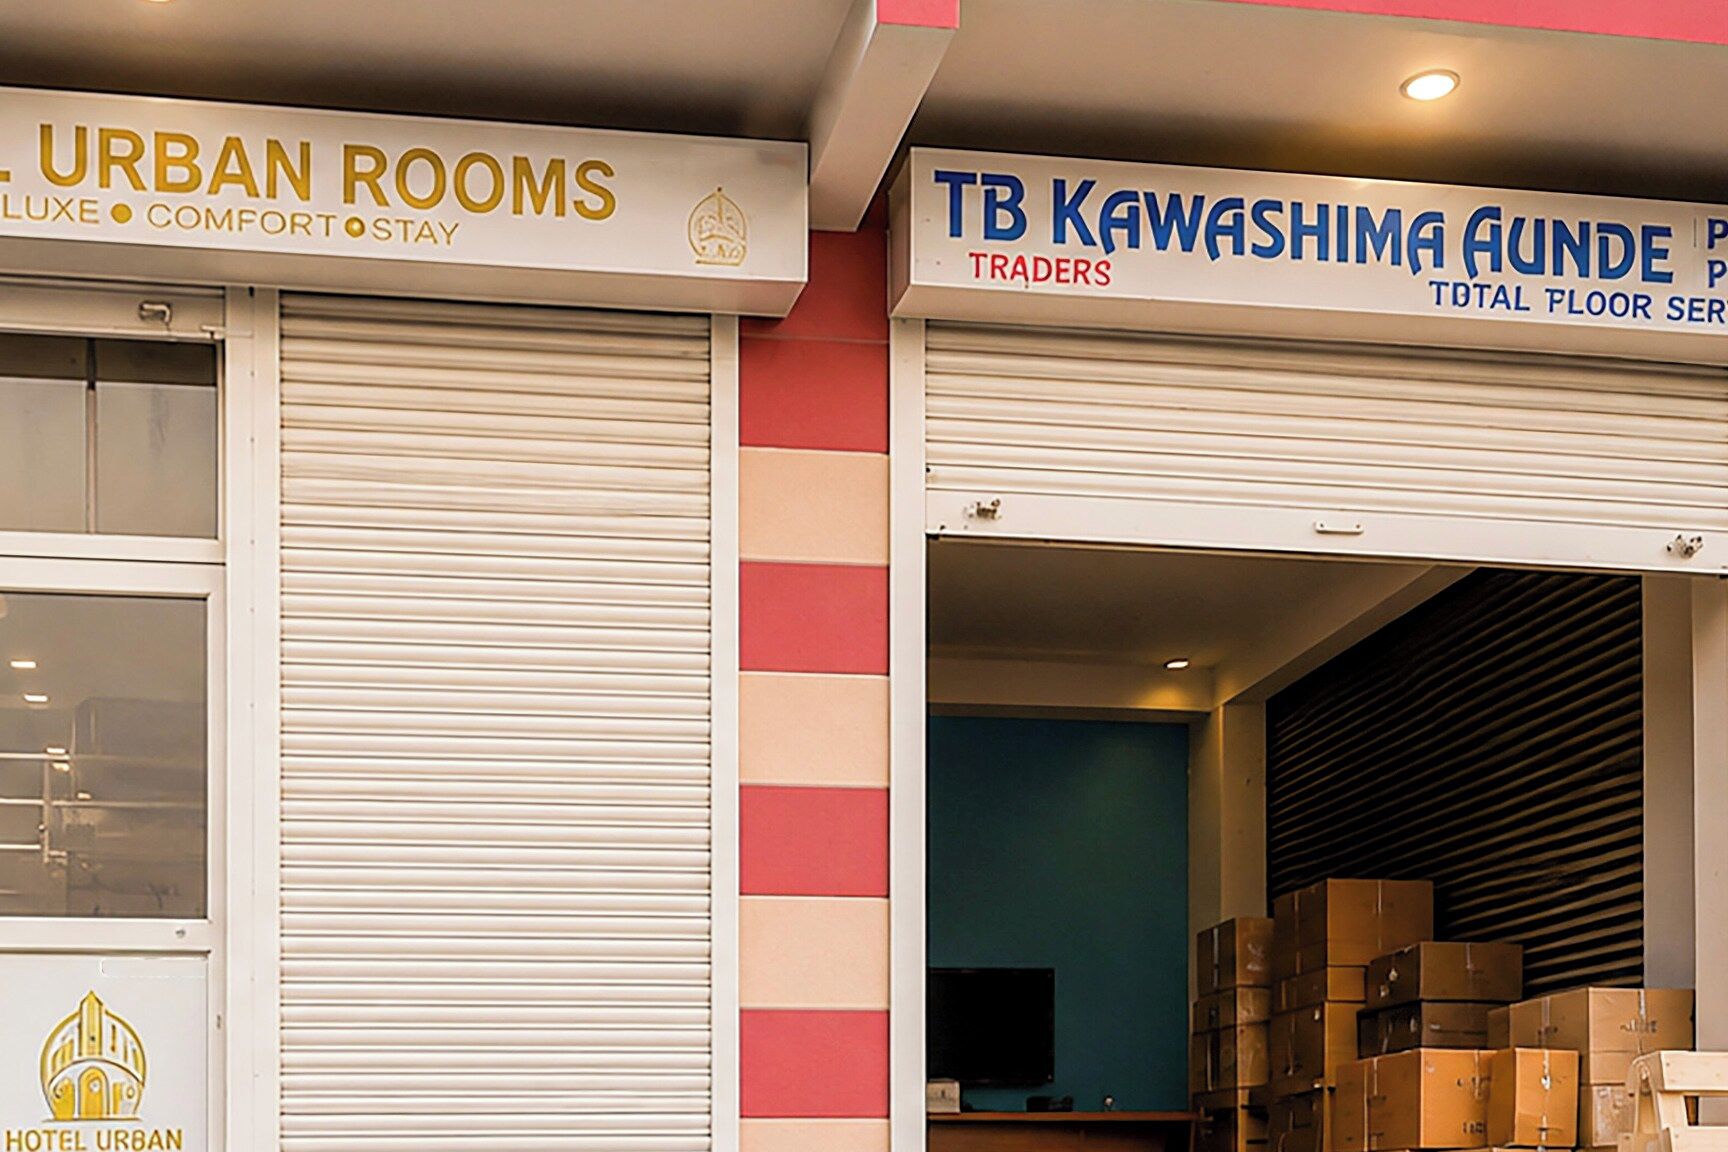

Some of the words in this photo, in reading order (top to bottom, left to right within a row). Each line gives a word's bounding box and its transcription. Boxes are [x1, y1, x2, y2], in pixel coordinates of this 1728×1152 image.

[40, 124, 311, 201] URBAN
[342, 144, 616, 221] ROOMS
[147, 203, 337, 236] COMFORT
[372, 217, 460, 245] STAY
[934, 170, 1027, 241] TB
[1052, 178, 1445, 275] KAWASHIMA
[1463, 206, 1673, 284] AUNDE
[969, 252, 1112, 286] TRADERS
[5, 1129, 87, 1152] HOTEL
[96, 1129, 183, 1152] URBAN
